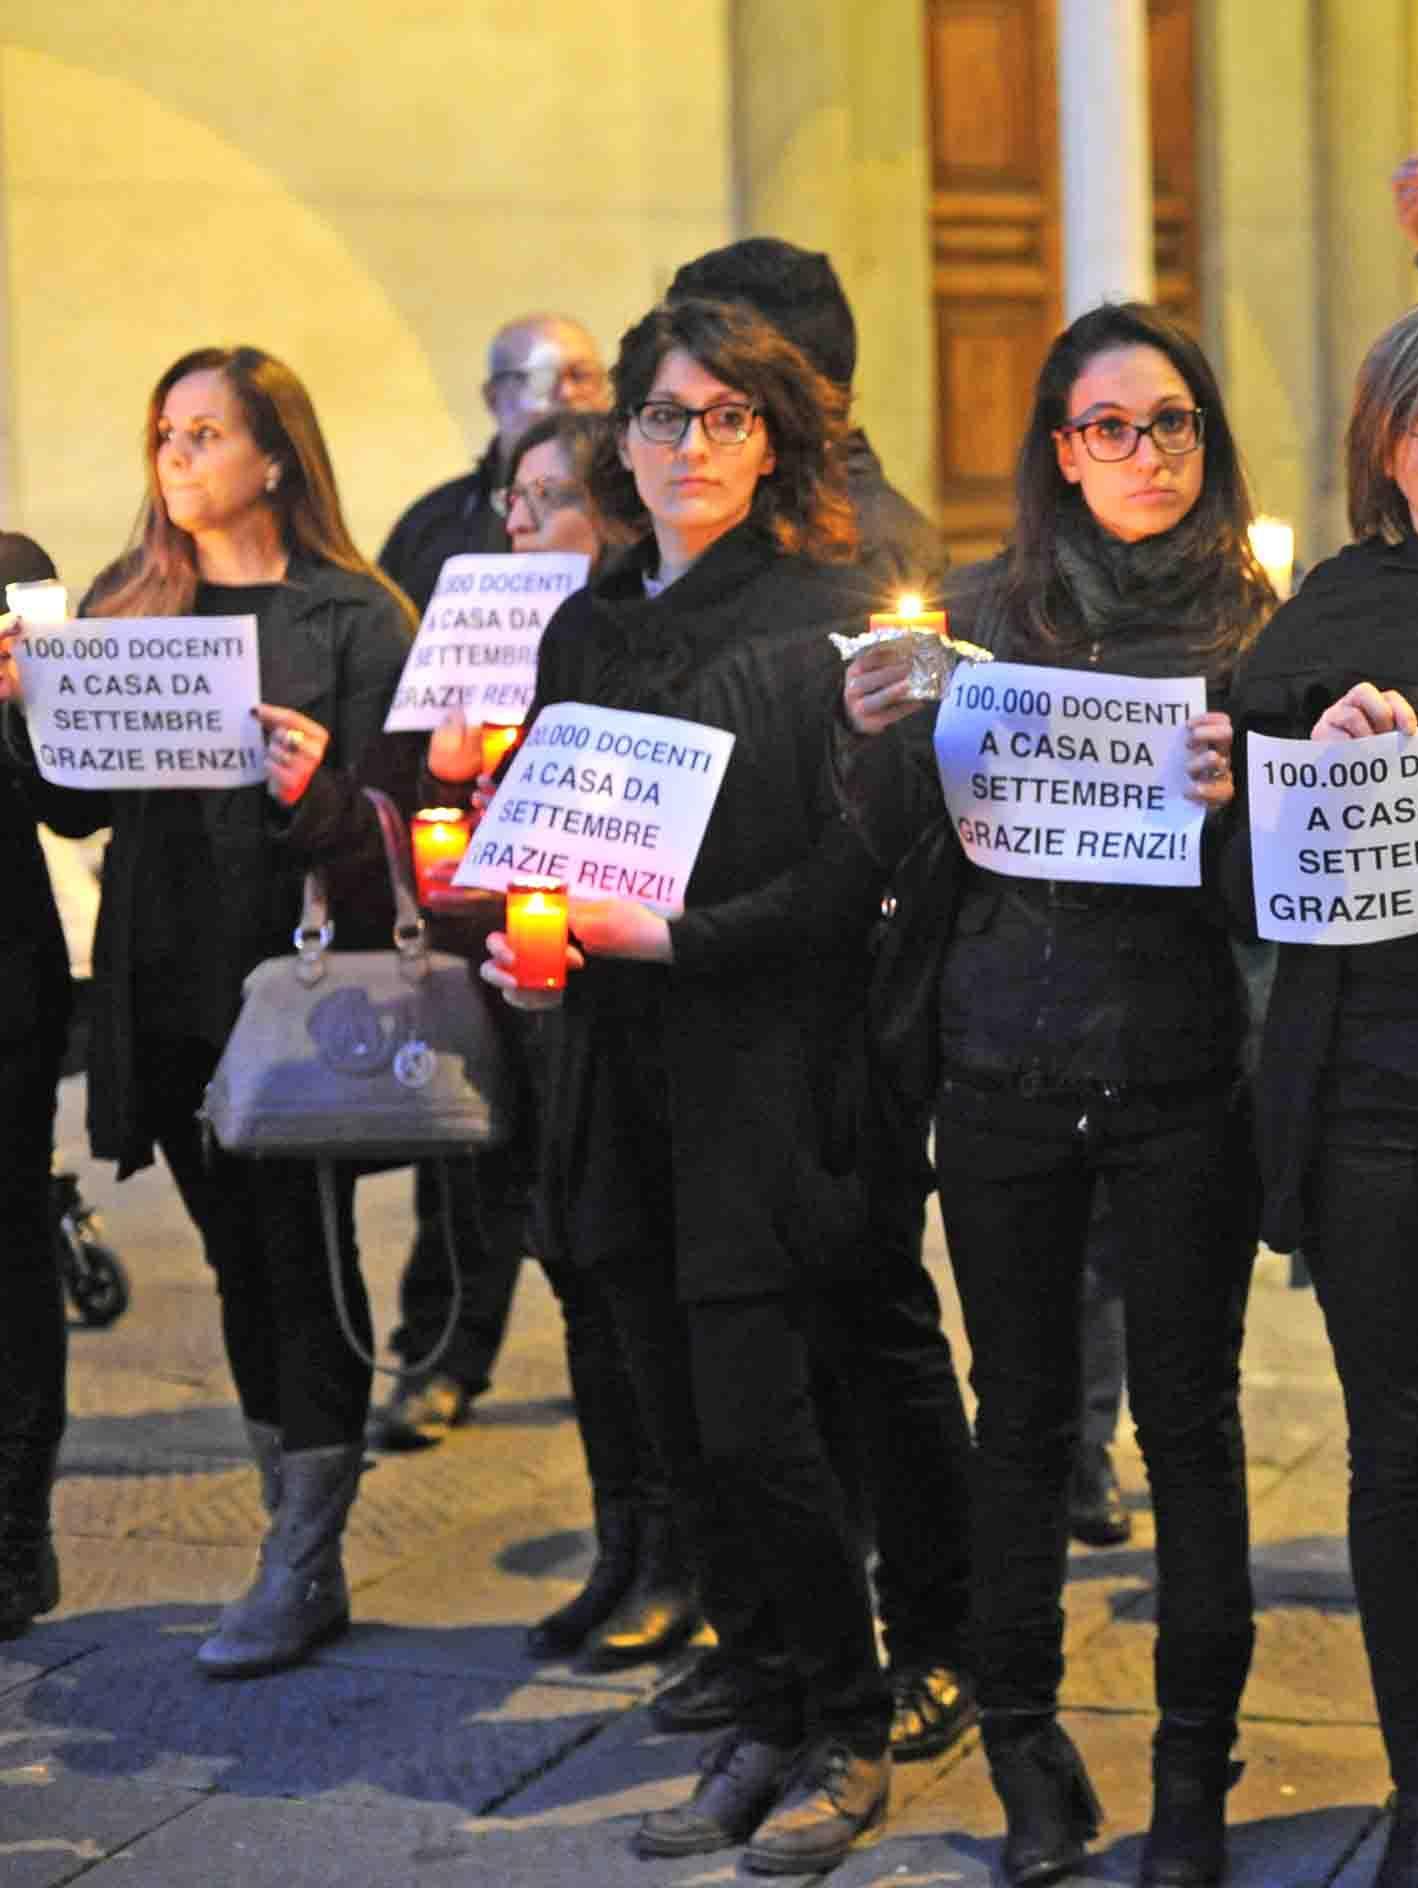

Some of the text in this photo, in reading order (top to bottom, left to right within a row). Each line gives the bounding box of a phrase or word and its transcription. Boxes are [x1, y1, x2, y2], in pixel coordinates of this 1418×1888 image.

[510, 608, 541, 629] DA
[22, 637, 244, 659] 100.000 DOCENTI
[58, 674, 211, 695] A CASA DA
[53, 709, 223, 731] SETTEMBRE
[954, 685, 1190, 726] 100.000 DOCENTI
[40, 744, 144, 770] GRAZIE
[595, 730, 711, 773] DOCENTI
[979, 731, 1154, 767] A CASA DA
[520, 762, 660, 807] A CASA DA
[1263, 758, 1388, 788] 100.000
[971, 773, 1165, 811] SETTEMBRE
[499, 800, 660, 849] SETTEMBRE
[1307, 807, 1330, 832] A
[958, 816, 1187, 861] GRAZIE RENZI!
[578, 860, 675, 903] RENZI!
[1269, 889, 1413, 923] GRAZIE
